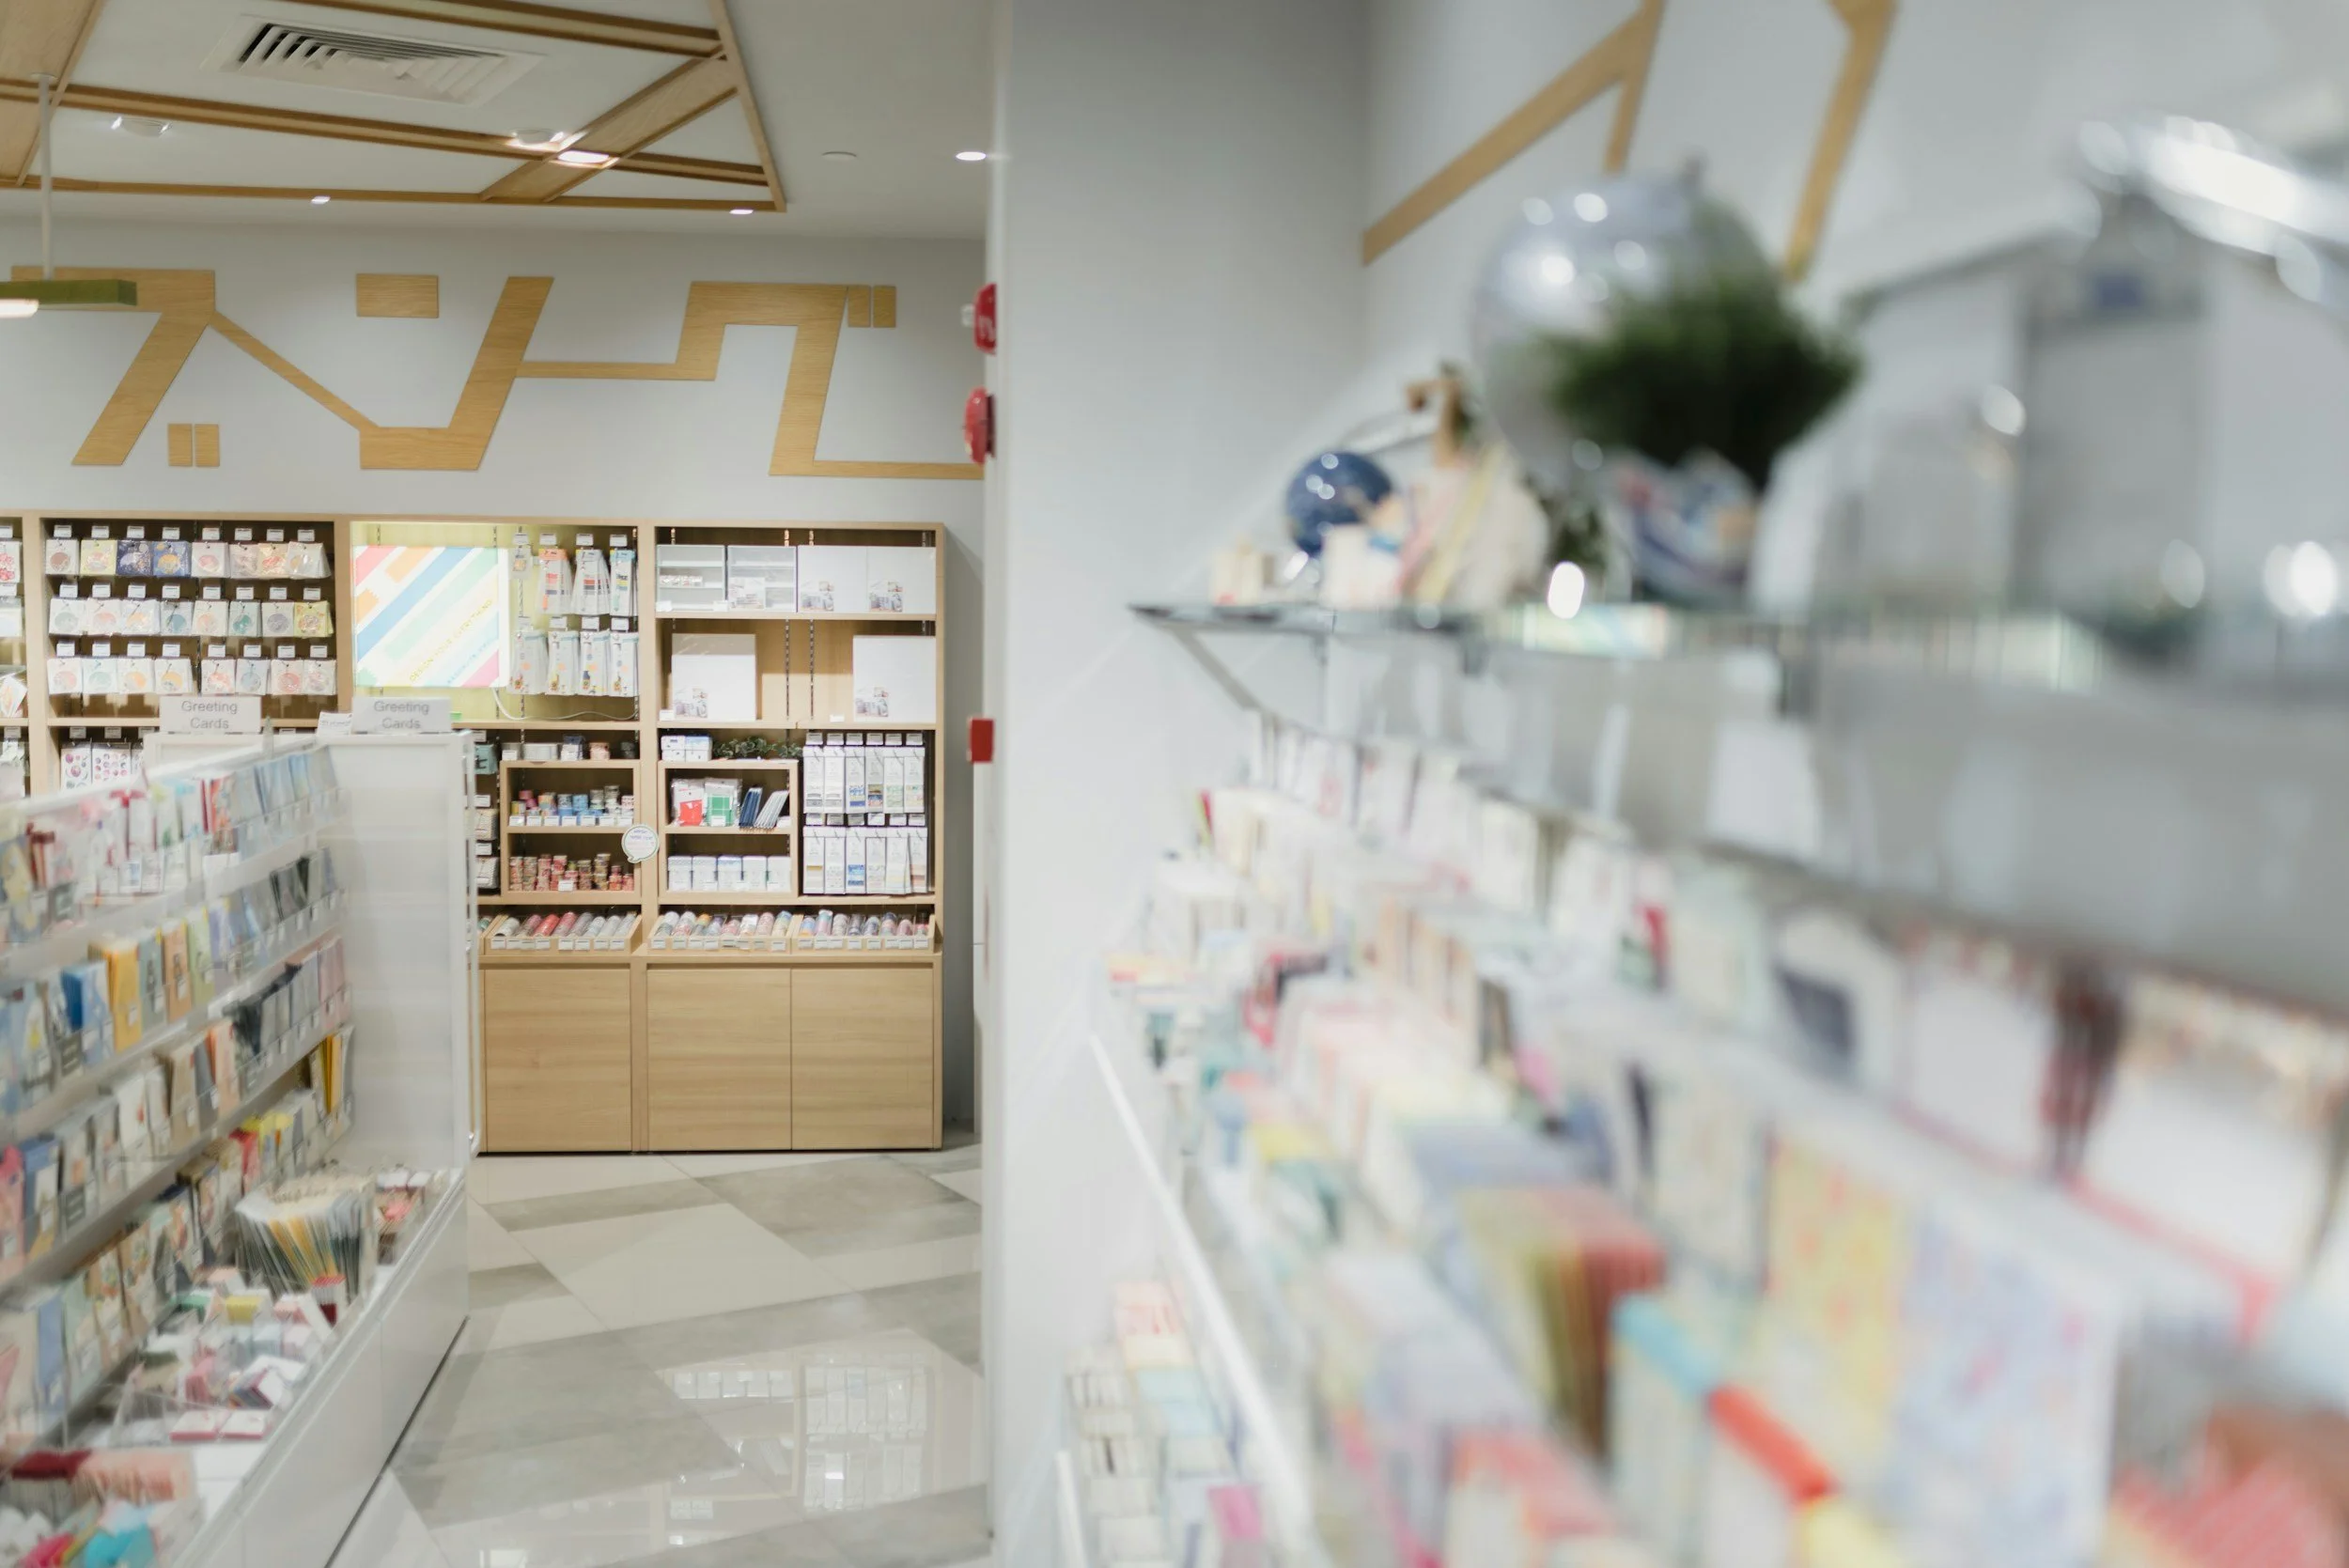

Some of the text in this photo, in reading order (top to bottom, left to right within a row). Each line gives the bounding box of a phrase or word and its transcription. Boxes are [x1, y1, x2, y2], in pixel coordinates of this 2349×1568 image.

[181, 701, 238, 714] Greeting
[373, 701, 429, 715] Greeting
[190, 717, 229, 729] Cards
[381, 718, 421, 729] Cards
